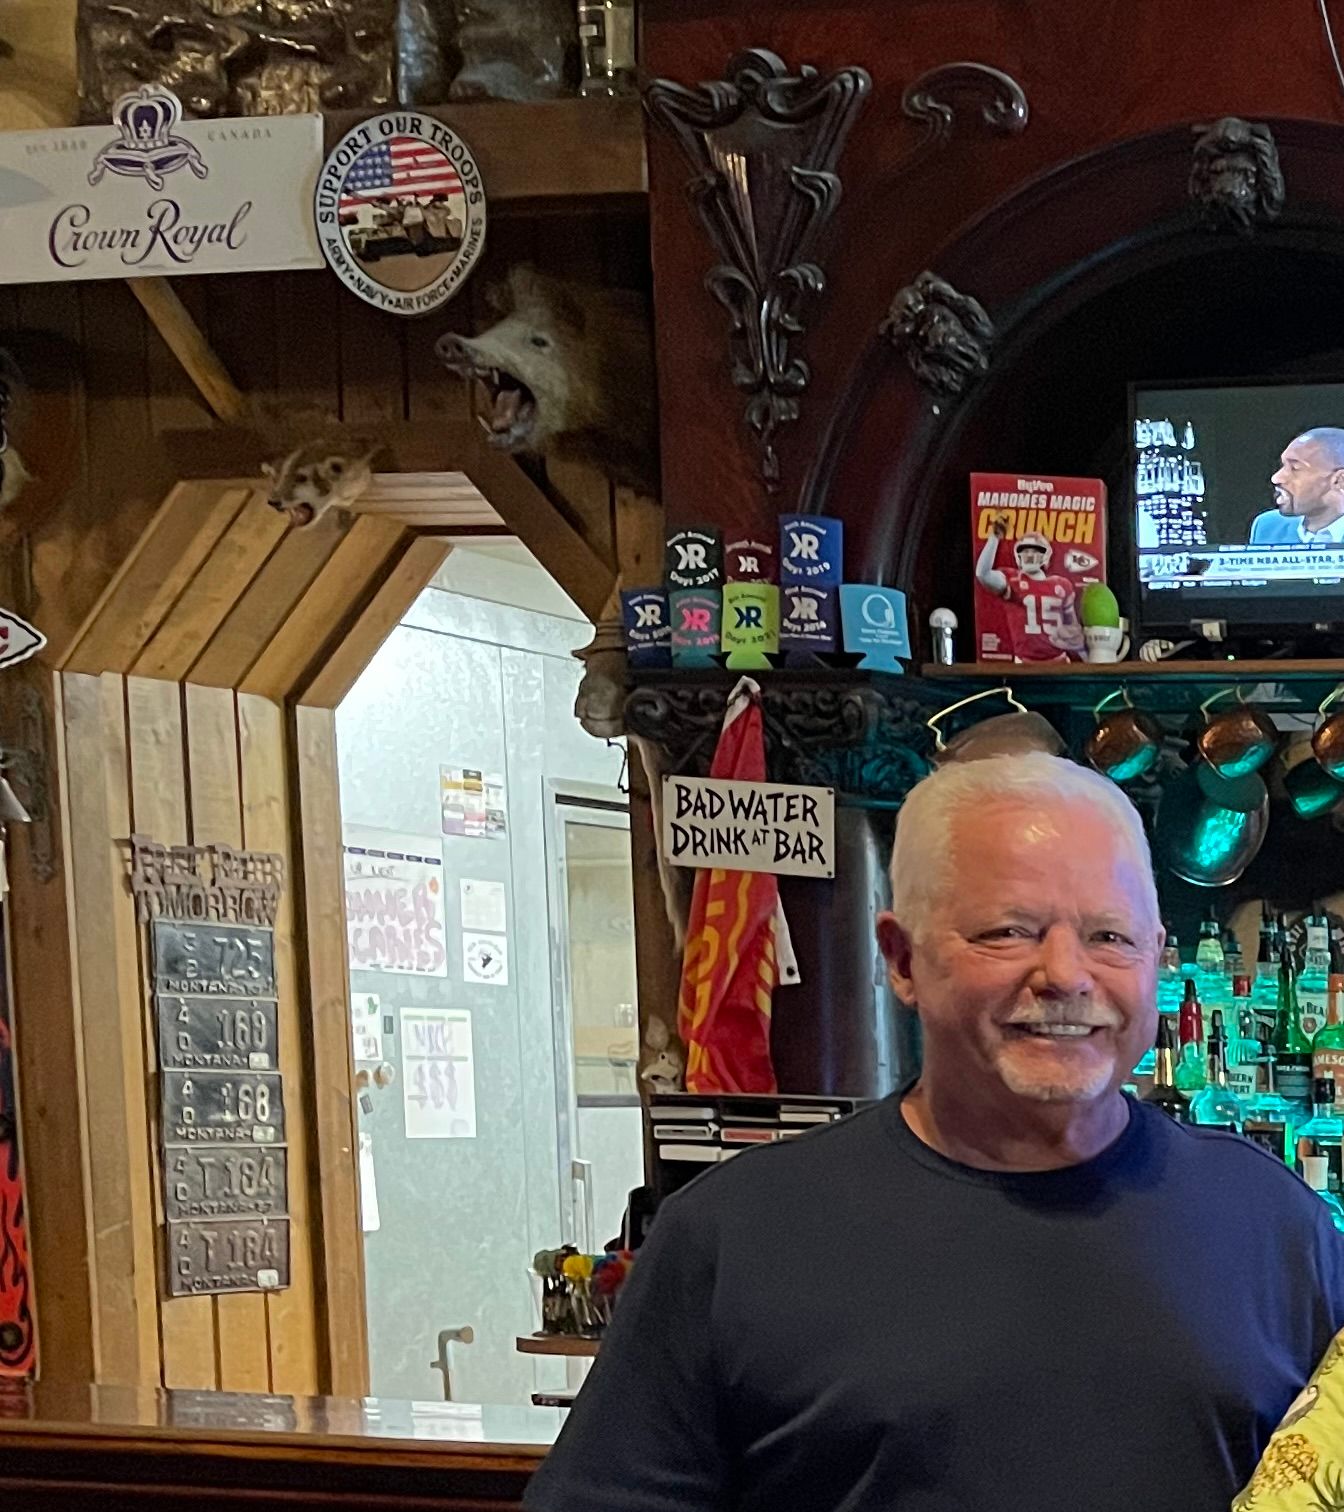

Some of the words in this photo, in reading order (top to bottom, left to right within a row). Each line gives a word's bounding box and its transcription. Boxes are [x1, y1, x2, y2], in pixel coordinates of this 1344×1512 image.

[320, 126, 371, 224] SUPPORT
[379, 117, 423, 136] OUR
[430, 124, 482, 204] TROOPS
[49, 204, 139, 268] Crown
[121, 199, 252, 265] Royal
[326, 237, 352, 274] ARMY
[352, 276, 389, 307] NAVY
[393, 296, 415, 311] AIR
[415, 279, 450, 308] FORCE
[454, 217, 483, 279] MARINES
[978, 492, 1047, 508] MAHOMES
[1050, 495, 1096, 511] MAGIC
[977, 508, 1096, 544] CRUNCH
[1257, 556, 1279, 565] NBA
[1023, 594, 1064, 640] 15
[675, 784, 725, 820] BAD
[728, 789, 819, 827] WATER
[670, 822, 750, 857] DRINK
[752, 828, 769, 846] AT
[773, 828, 826, 865] BAR
